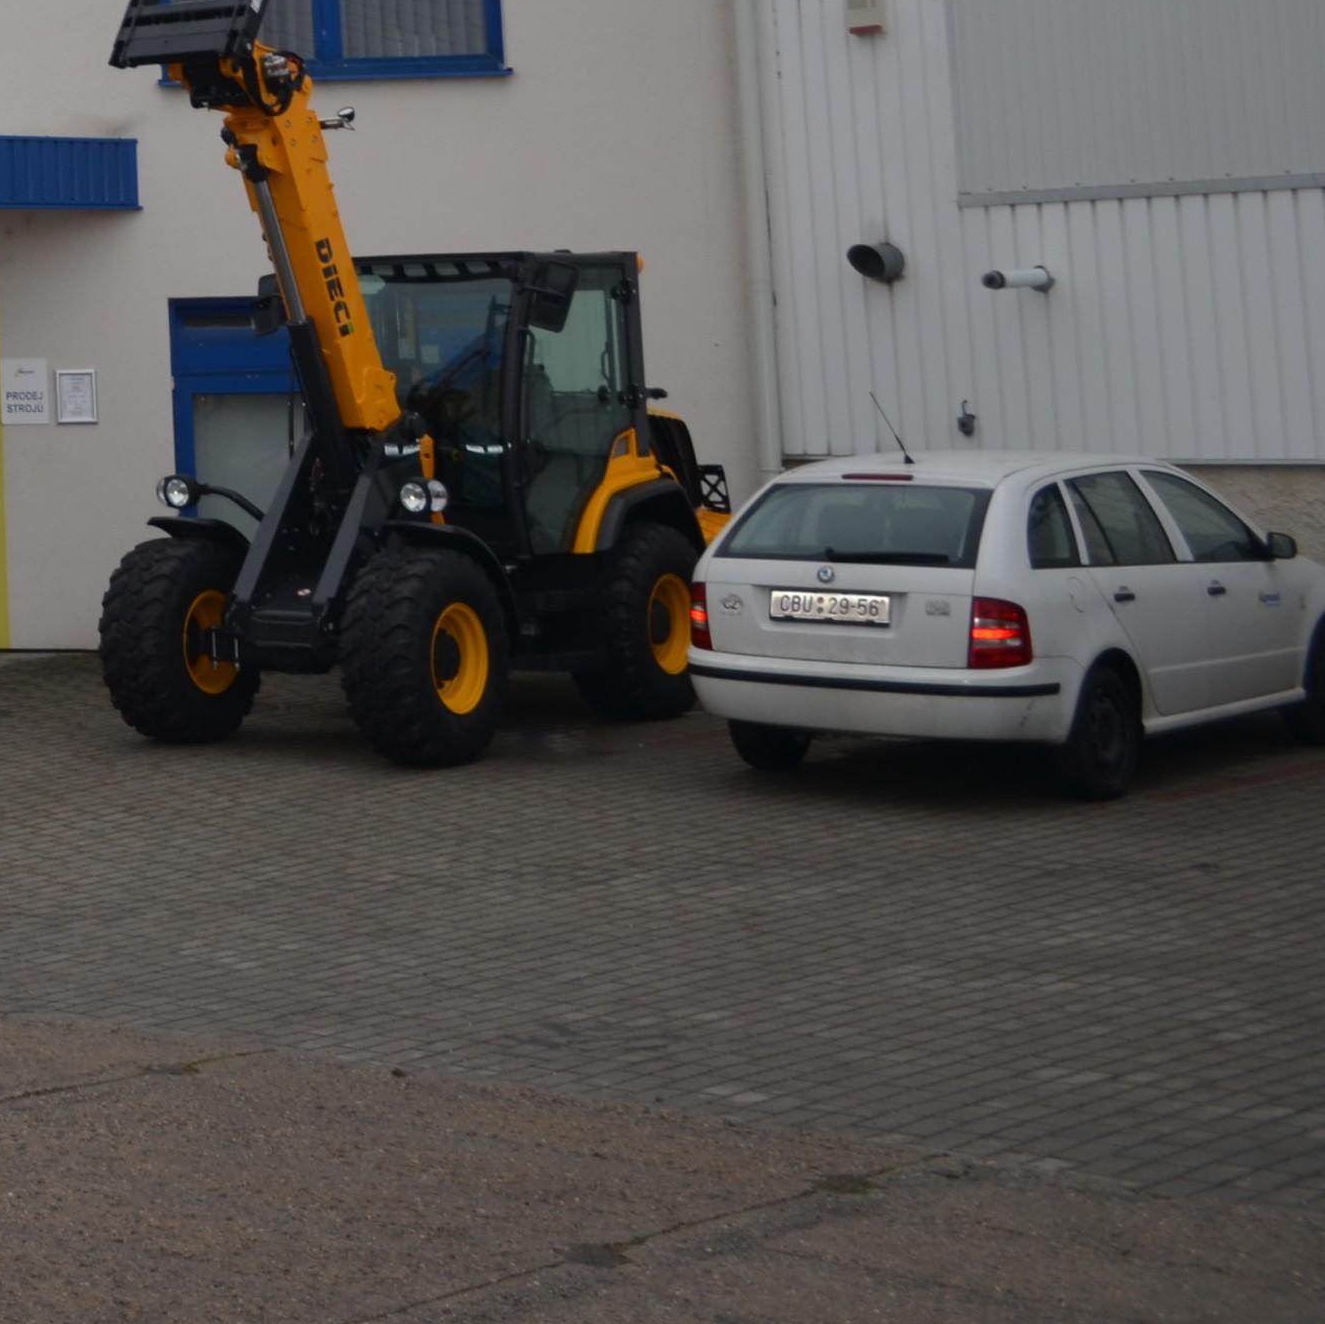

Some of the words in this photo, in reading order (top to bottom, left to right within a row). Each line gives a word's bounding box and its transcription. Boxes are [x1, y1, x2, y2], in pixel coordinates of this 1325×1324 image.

[315, 238, 354, 337] DIECI
[6, 391, 44, 401] PRODEJ
[780, 594, 813, 613] CBU
[828, 597, 880, 616] 29-56
